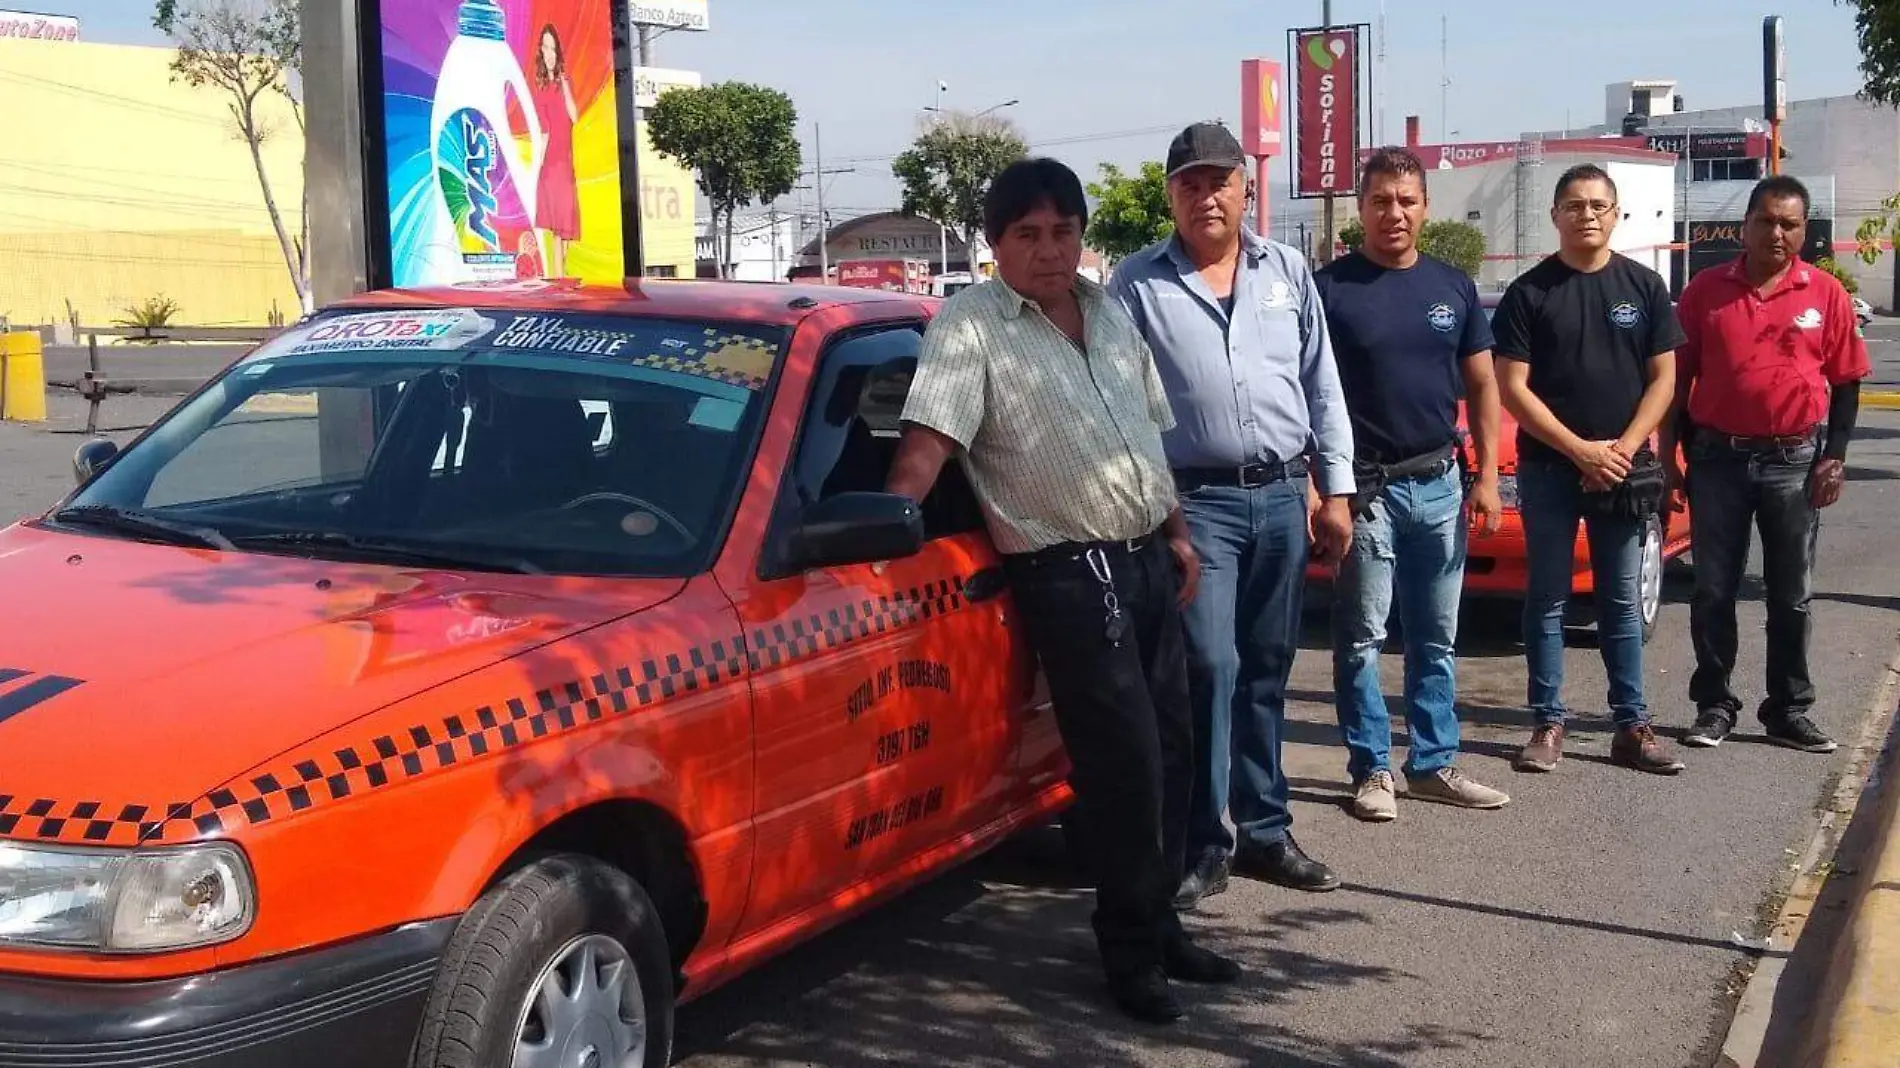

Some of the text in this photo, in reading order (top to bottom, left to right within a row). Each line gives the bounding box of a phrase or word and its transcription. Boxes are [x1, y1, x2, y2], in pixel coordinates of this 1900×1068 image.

[1320, 73, 1336, 188] Soriana
[1440, 145, 1486, 161] Plaza
[506, 316, 563, 334] TAXI
[492, 330, 629, 356] CONFIABLE
